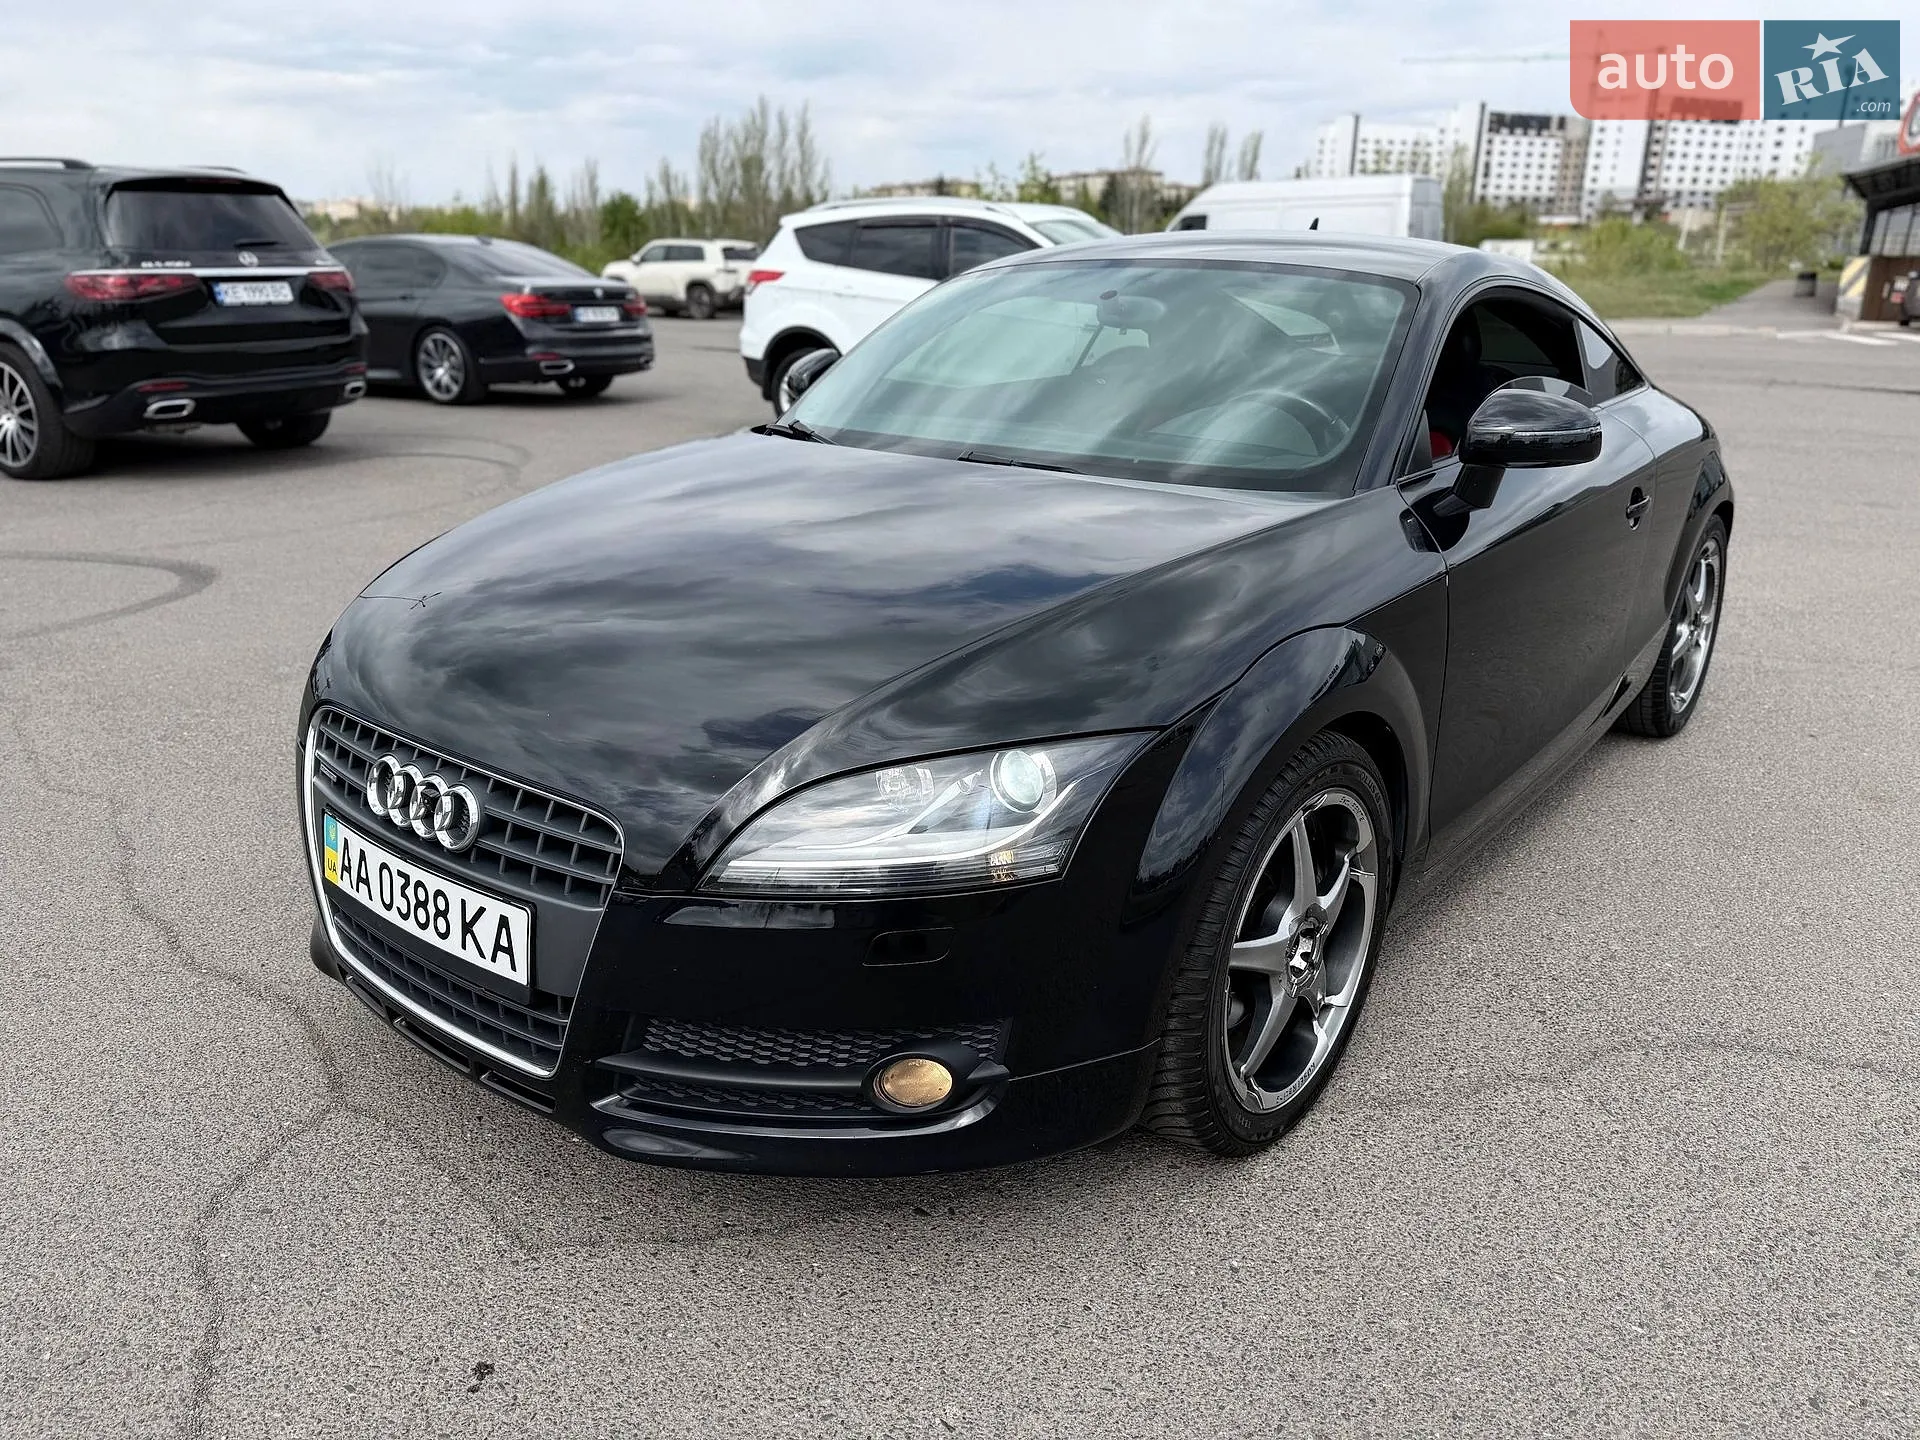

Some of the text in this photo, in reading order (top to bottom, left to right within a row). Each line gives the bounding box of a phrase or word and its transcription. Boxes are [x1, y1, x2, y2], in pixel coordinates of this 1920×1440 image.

[327, 857, 338, 875] UA
[340, 837, 517, 972] AA 0388 KA
